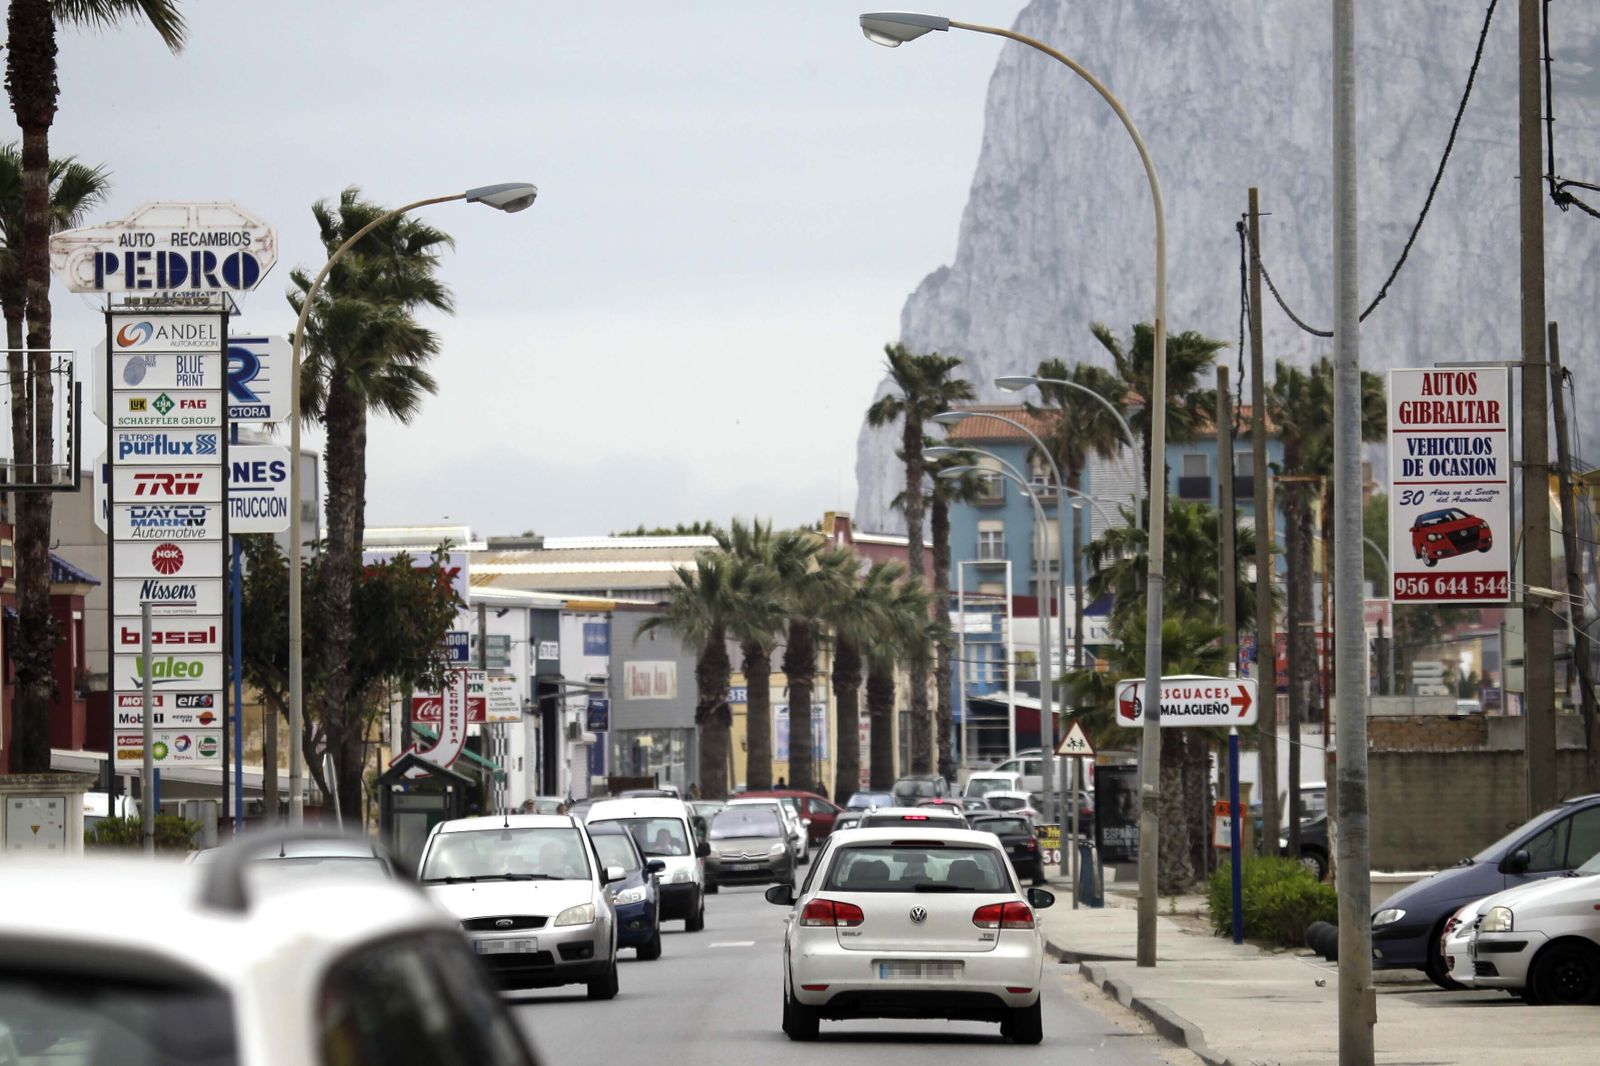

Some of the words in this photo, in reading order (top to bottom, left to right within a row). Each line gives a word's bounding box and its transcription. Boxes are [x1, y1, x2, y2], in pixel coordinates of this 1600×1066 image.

[119, 233, 155, 247] AUTO
[171, 232, 251, 247] RECAMBIOS
[94, 250, 260, 290] PEDRO
[155, 324, 217, 340] ANDEL
[176, 355, 204, 374] BLUE
[176, 375, 204, 387] PRINT
[1421, 372, 1477, 396] AUTOS
[180, 400, 207, 409] FAG
[1399, 400, 1500, 424] GIBRALTAR
[228, 407, 268, 418] CTORA
[118, 417, 179, 425] SCHAEFFLER
[181, 417, 216, 425] GROUP
[119, 434, 193, 460] purflux
[1407, 437, 1492, 456] VEHICULOS
[228, 461, 287, 483] NES
[1402, 459, 1424, 477] DE
[1429, 457, 1497, 477] OCASION
[133, 473, 204, 496] TRW
[1399, 490, 1425, 506] 30
[130, 505, 206, 518] DAYCO
[230, 497, 287, 518] TRUCCION
[131, 527, 206, 538] Automotive
[156, 551, 179, 559] NGK
[139, 579, 197, 600] Nissens
[1395, 577, 1430, 596] 956
[1434, 577, 1469, 595] 644
[1474, 576, 1508, 595] 544
[466, 673, 486, 681] NTE
[177, 695, 199, 707] elf
[1160, 688, 1229, 699] SGUACES
[122, 697, 160, 706] MOTL
[1160, 702, 1229, 716] MALAGUEÑO
[119, 713, 144, 724] Mob
